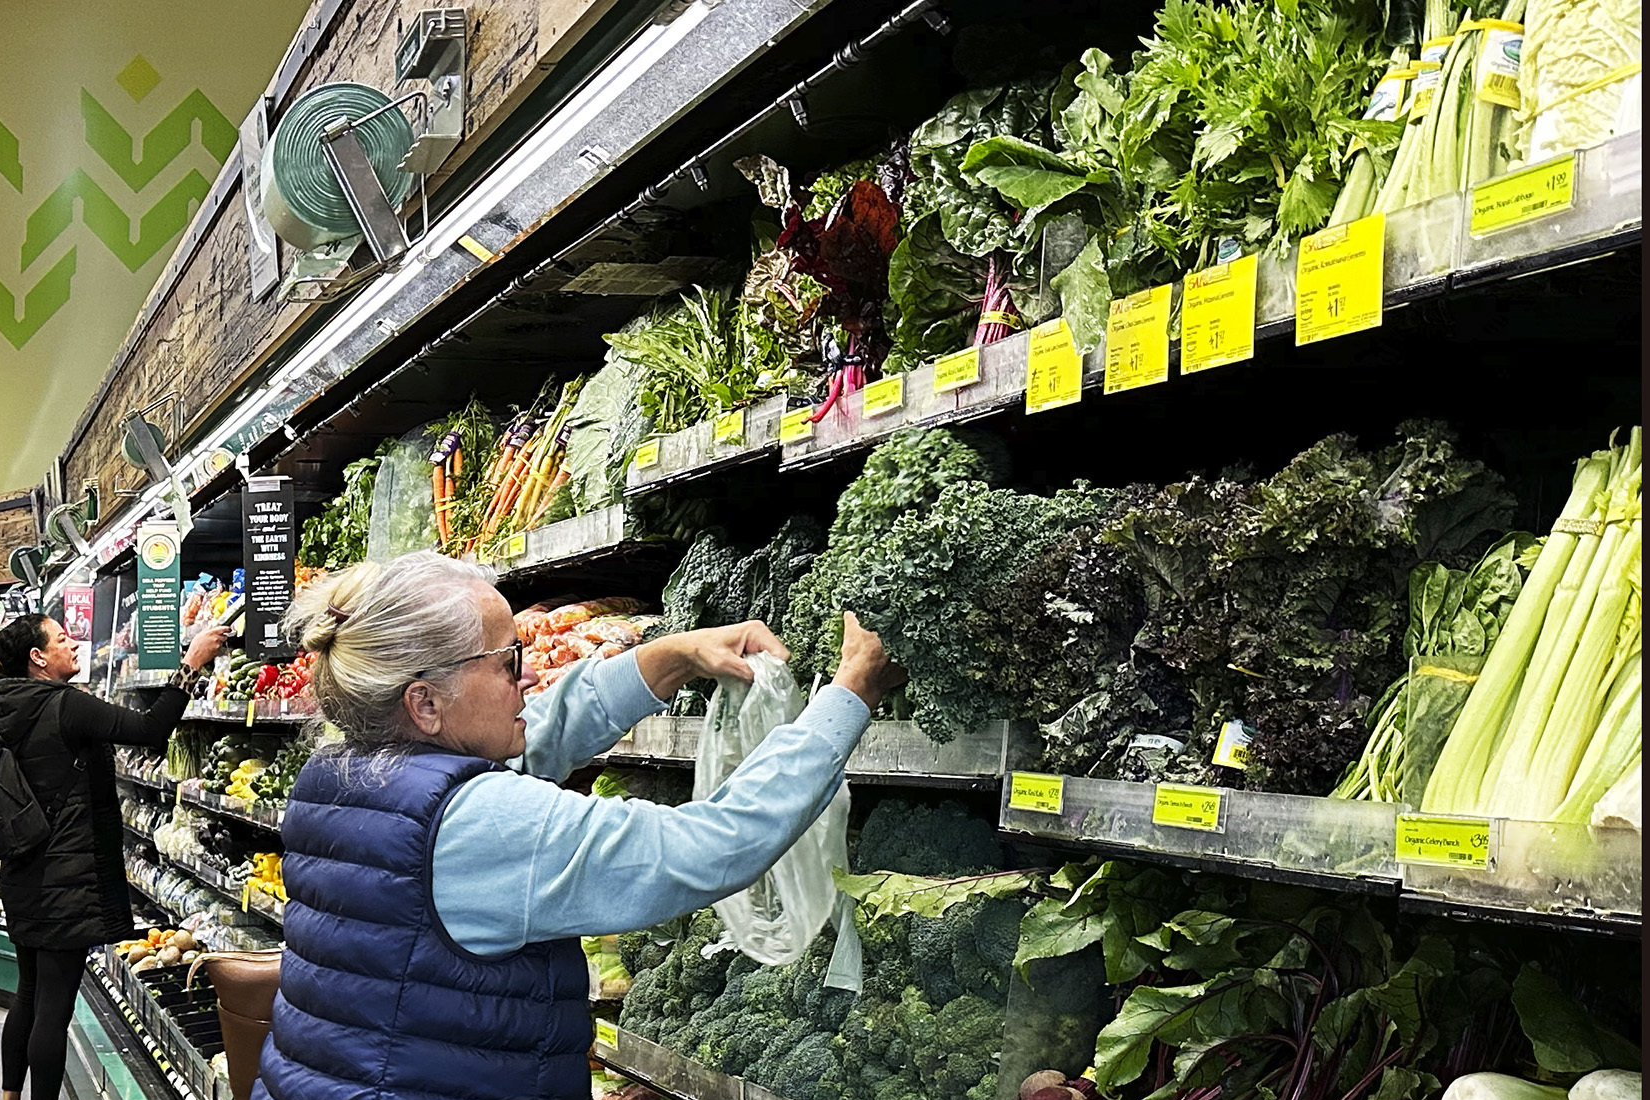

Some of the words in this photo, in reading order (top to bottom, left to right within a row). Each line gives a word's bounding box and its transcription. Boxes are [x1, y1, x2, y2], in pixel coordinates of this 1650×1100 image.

[255, 502, 282, 513] TREAT
[249, 514, 268, 524] YOUR
[269, 513, 289, 523] BODY
[251, 534, 265, 543] THE
[265, 534, 288, 543] EARTH
[260, 543, 279, 552] WITH
[68, 593, 90, 604] LOCAL
[1405, 836, 1424, 845] Organic
[1425, 837, 1442, 847] Celery
